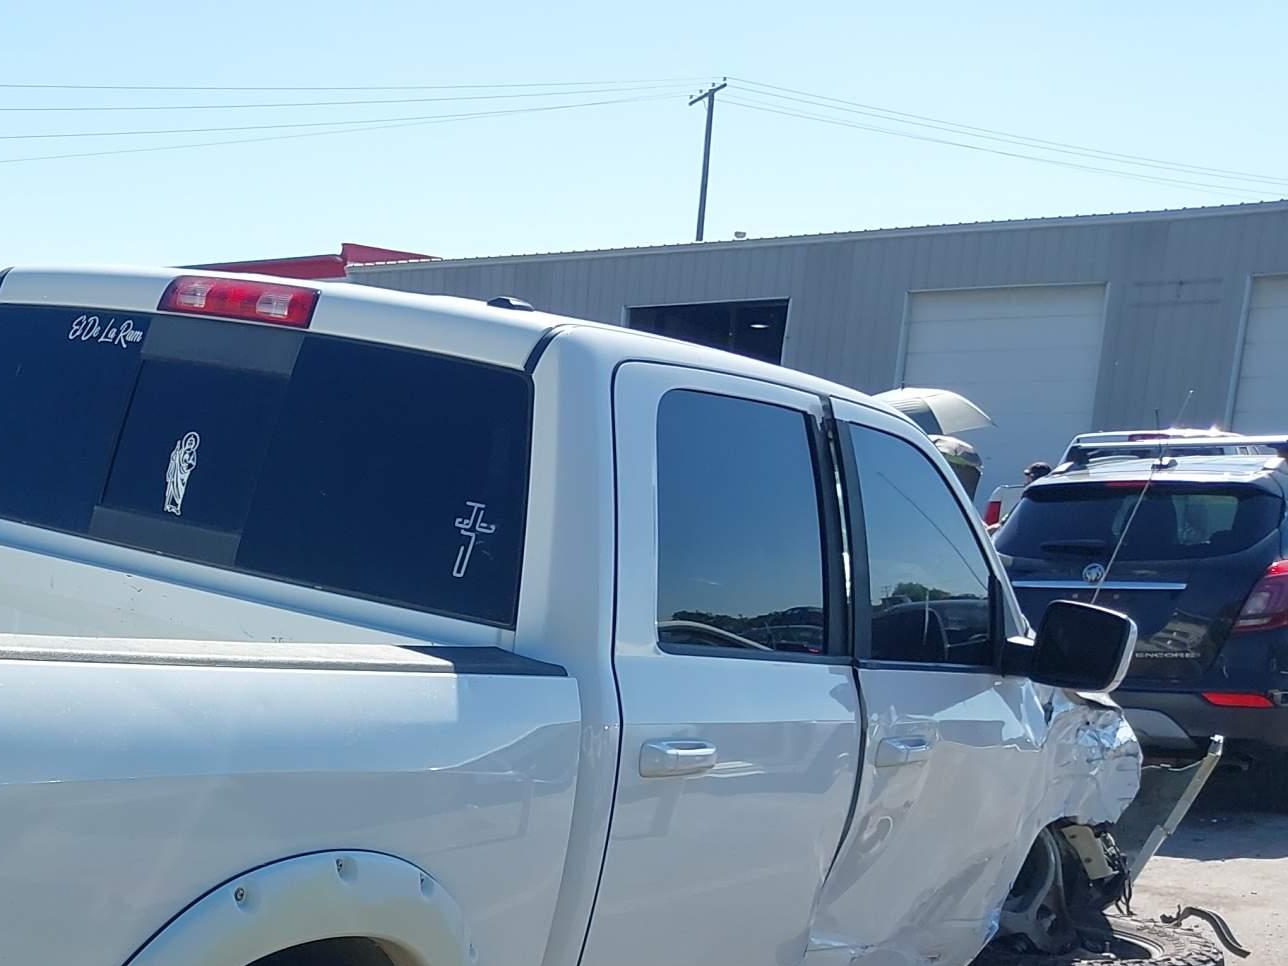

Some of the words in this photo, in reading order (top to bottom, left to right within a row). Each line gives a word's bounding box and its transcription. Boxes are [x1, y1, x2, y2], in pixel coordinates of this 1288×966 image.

[81, 315, 101, 341] De
[98, 318, 118, 343] La
[114, 319, 143, 348] Ram
